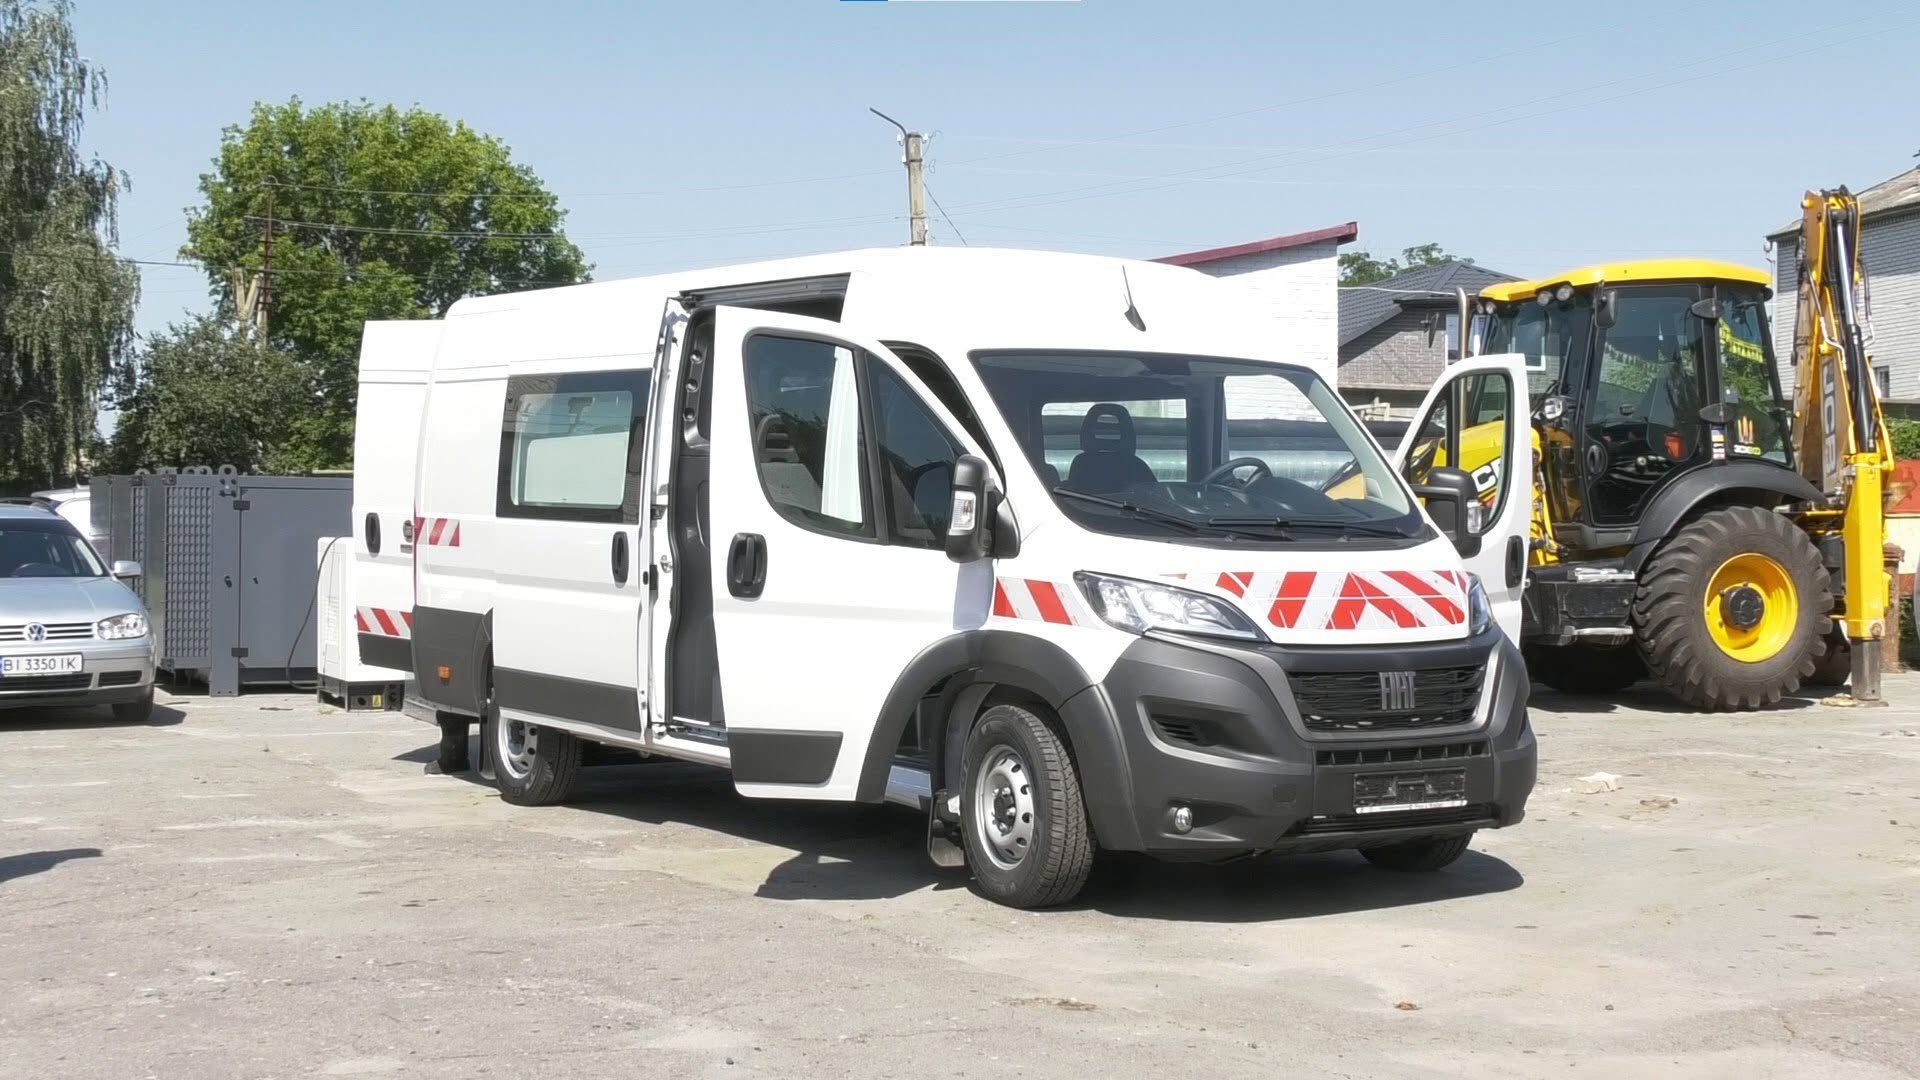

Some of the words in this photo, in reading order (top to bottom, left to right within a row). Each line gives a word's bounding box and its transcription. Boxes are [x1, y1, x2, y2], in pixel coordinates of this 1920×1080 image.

[3, 659, 20, 672] BI
[25, 658, 56, 671] 3350
[61, 657, 76, 670] IK
[1379, 671, 1416, 710] FIAT
